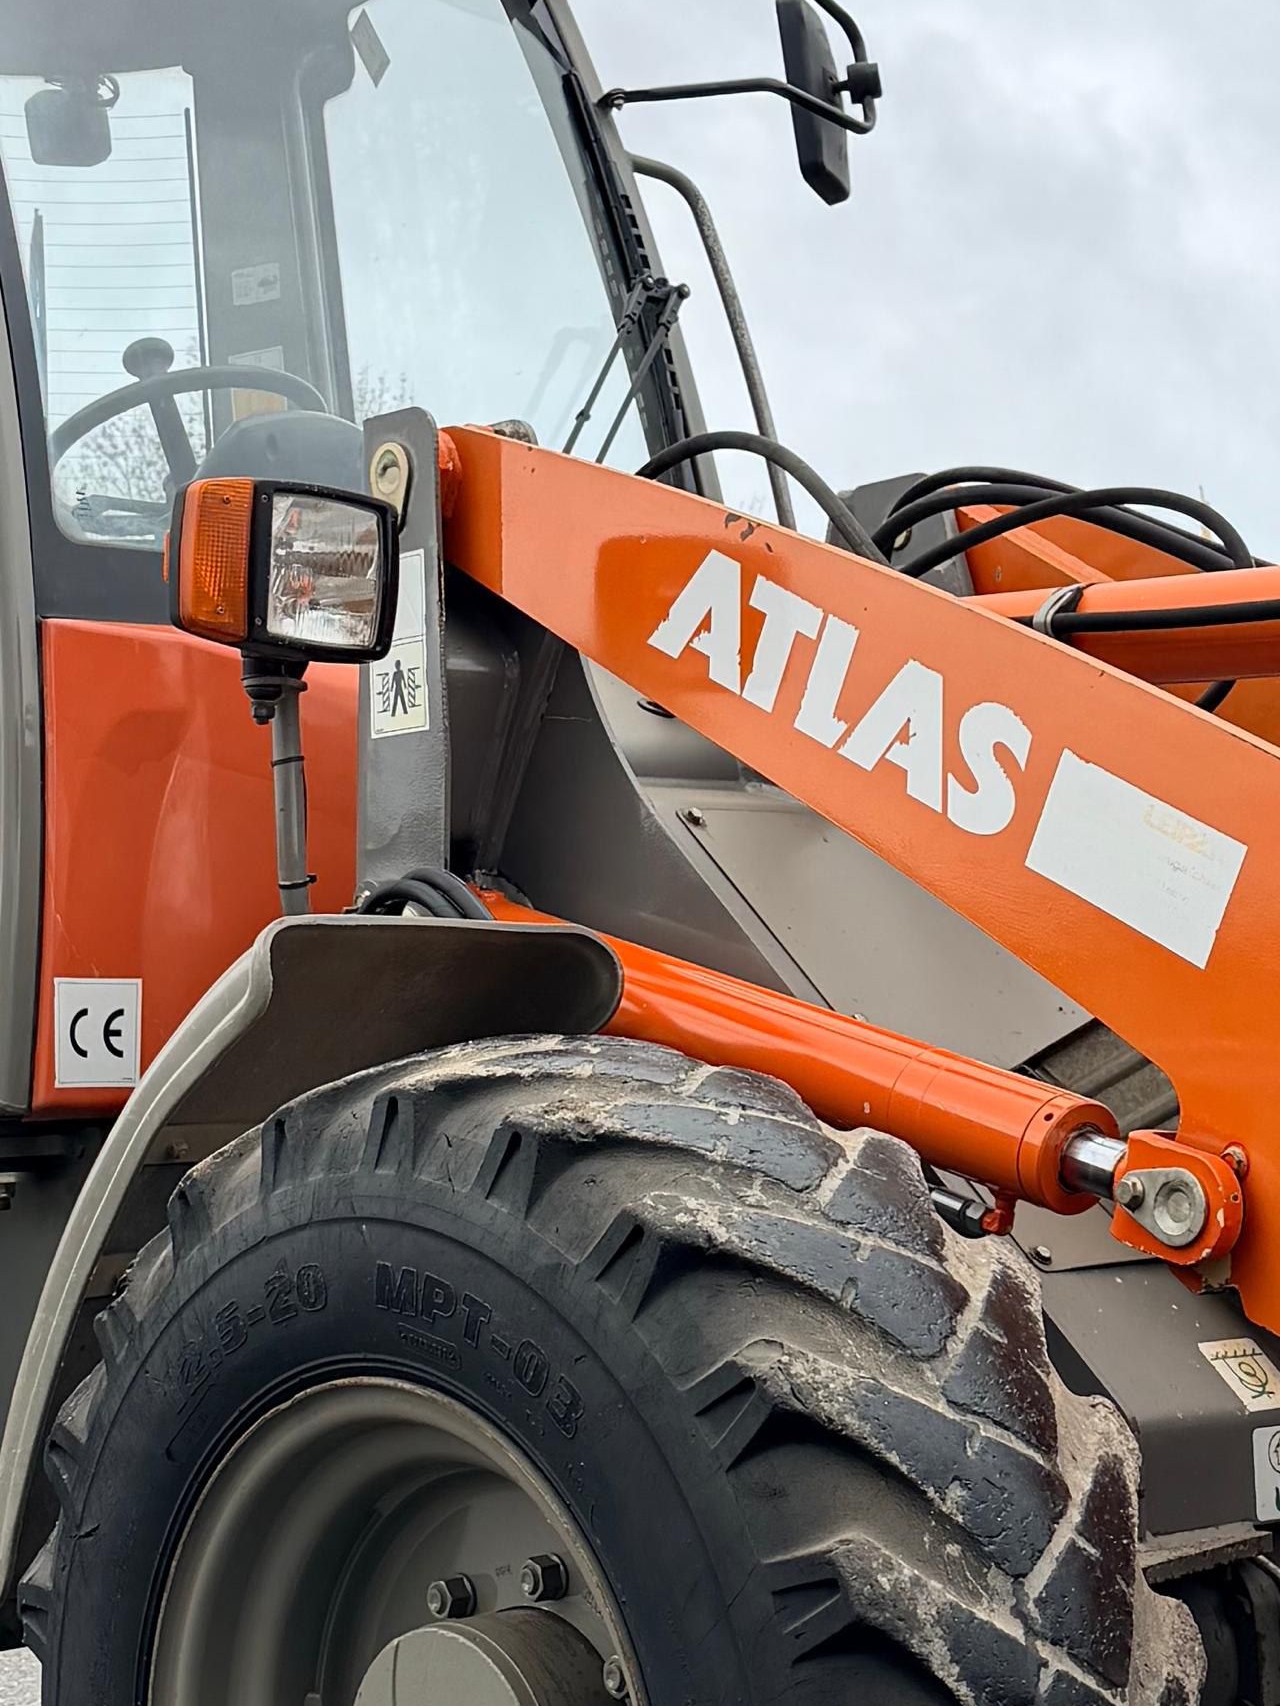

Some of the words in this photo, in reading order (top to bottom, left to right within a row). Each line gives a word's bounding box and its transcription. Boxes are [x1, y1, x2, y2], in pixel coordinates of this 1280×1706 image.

[647, 549, 1032, 836] ATLAS
[69, 1007, 125, 1059] CE
[374, 1259, 585, 1439] MPT-03
